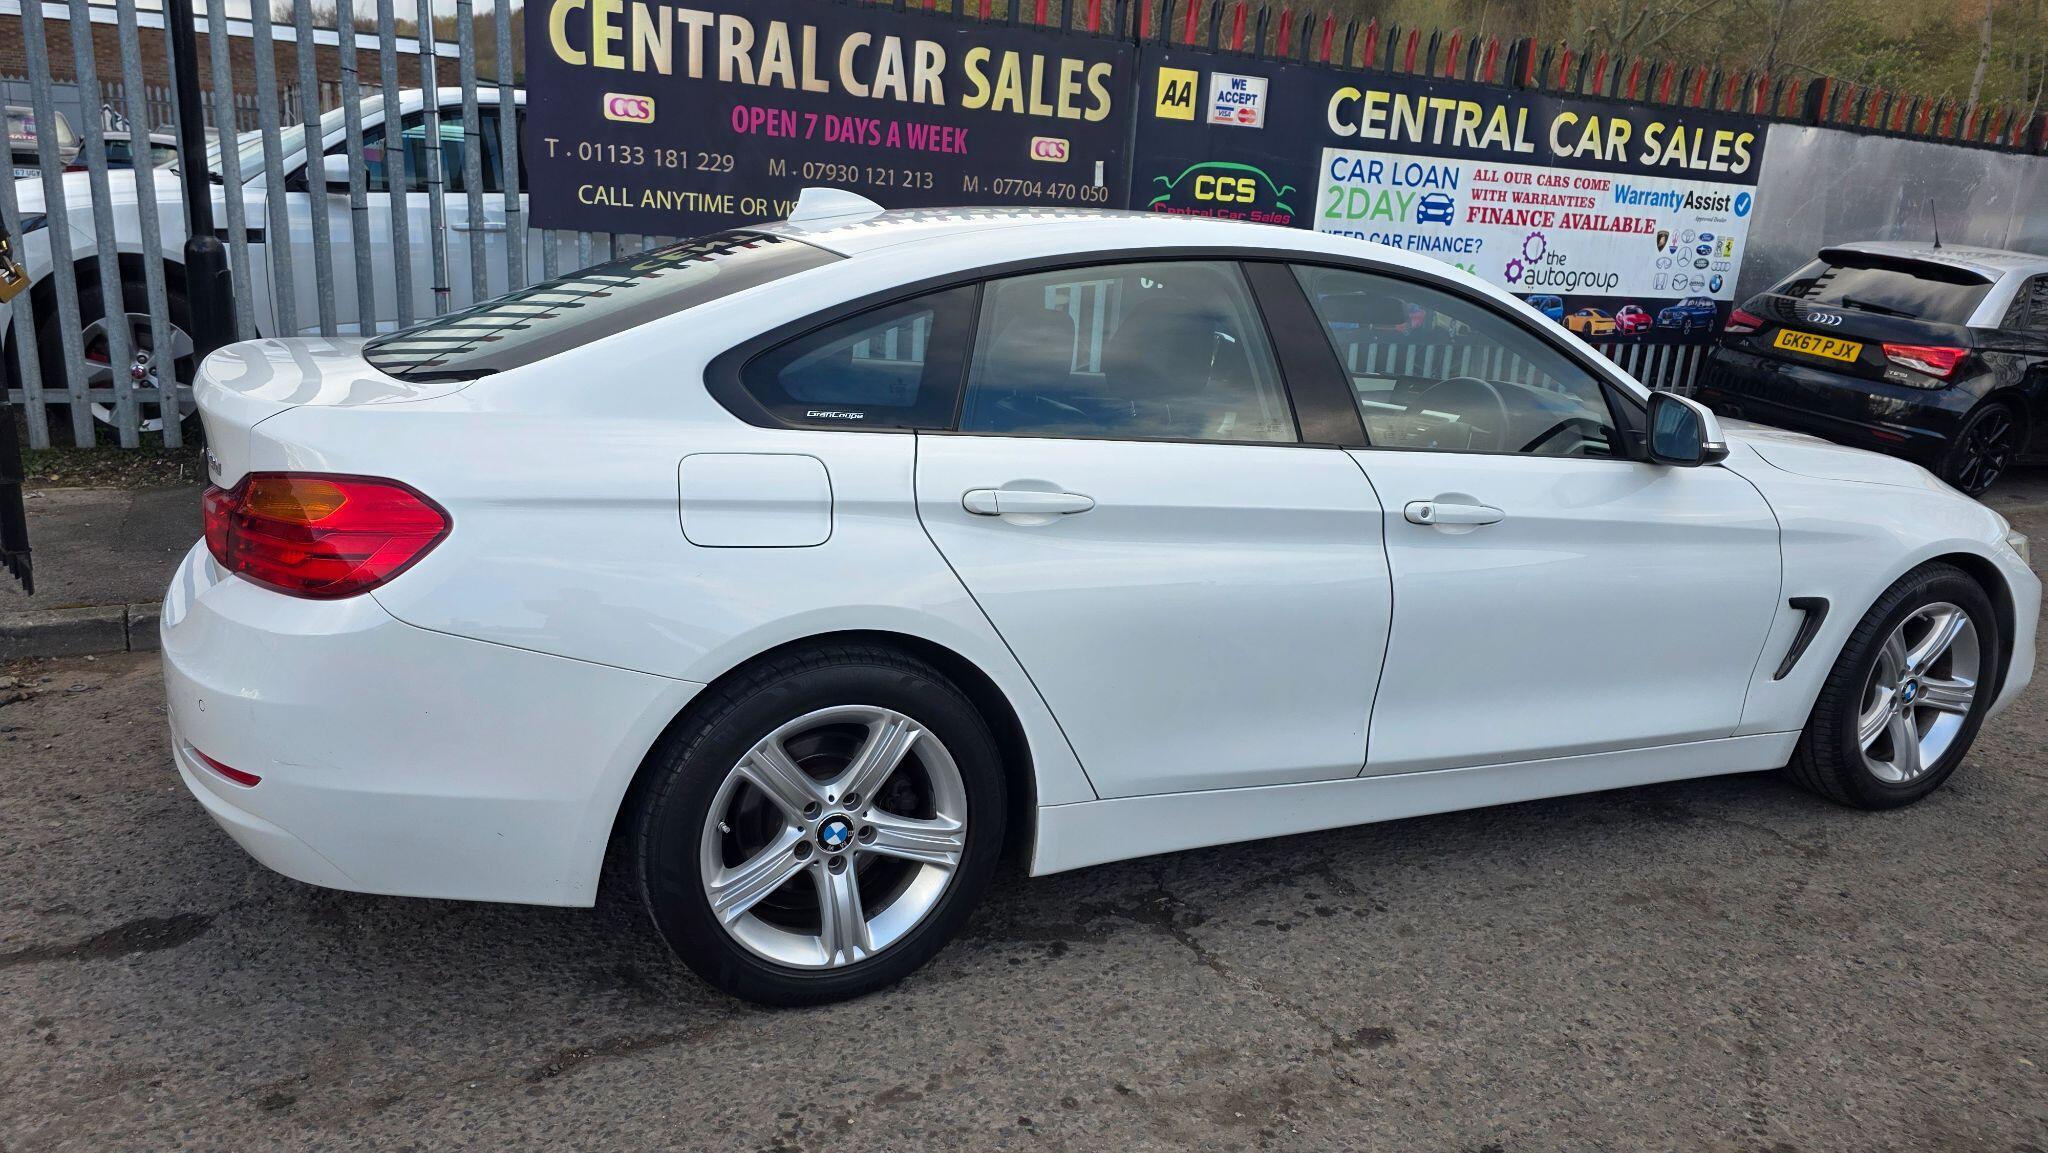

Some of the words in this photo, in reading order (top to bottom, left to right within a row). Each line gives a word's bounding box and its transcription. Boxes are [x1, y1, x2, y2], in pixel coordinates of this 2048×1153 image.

[549, 0, 829, 93] CENTRAL
[839, 31, 946, 106] CAR
[961, 46, 1113, 122] SALES
[1160, 79, 1192, 107] AA
[1217, 90, 1258, 105] ACCEPT
[1231, 77, 1247, 91] WE
[731, 104, 797, 138] OPEN
[804, 113, 818, 139] 7
[824, 114, 881, 146] DAYS
[886, 120, 901, 149] A
[906, 122, 969, 154] WEEK
[1327, 86, 1535, 153] CENTRAL
[1549, 111, 1632, 163] CAR
[1639, 121, 1755, 175] SALES
[544, 137, 559, 158] T
[578, 141, 645, 165] 01133
[654, 149, 688, 169] 181
[696, 152, 735, 173] 229
[768, 158, 786, 177] M
[802, 161, 859, 183] 07930
[866, 167, 894, 186] 121
[902, 170, 934, 189] 213
[1330, 156, 1384, 185] CAR
[1392, 162, 1460, 190] LOAN
[1473, 168, 1499, 183] ALL
[1504, 172, 1533, 186] OUR
[1536, 174, 1570, 189] CARS
[1573, 177, 1611, 192] COME
[577, 184, 634, 208] CALL
[640, 189, 734, 214] ANYTIME
[739, 197, 768, 216] OR
[963, 174, 979, 193] M
[992, 178, 1042, 198] 07704
[1046, 183, 1076, 200] 470
[1080, 185, 1109, 203] 050
[1195, 175, 1256, 203] CCS
[1471, 188, 1508, 203] WITH
[1512, 191, 1596, 209] WARRANTIES
[1217, 209, 1247, 220] Car
[1251, 210, 1291, 225] Sales
[1324, 184, 1417, 222] 2DAY
[1466, 206, 1555, 229] FINANCE
[1558, 212, 1657, 235] AVAILABLE
[1407, 235, 1483, 254] FINANCE?
[1546, 250, 1567, 266] the
[1524, 267, 1619, 292] autogroup
[1782, 333, 1822, 351] GK67
[1822, 340, 1856, 358] PJX
